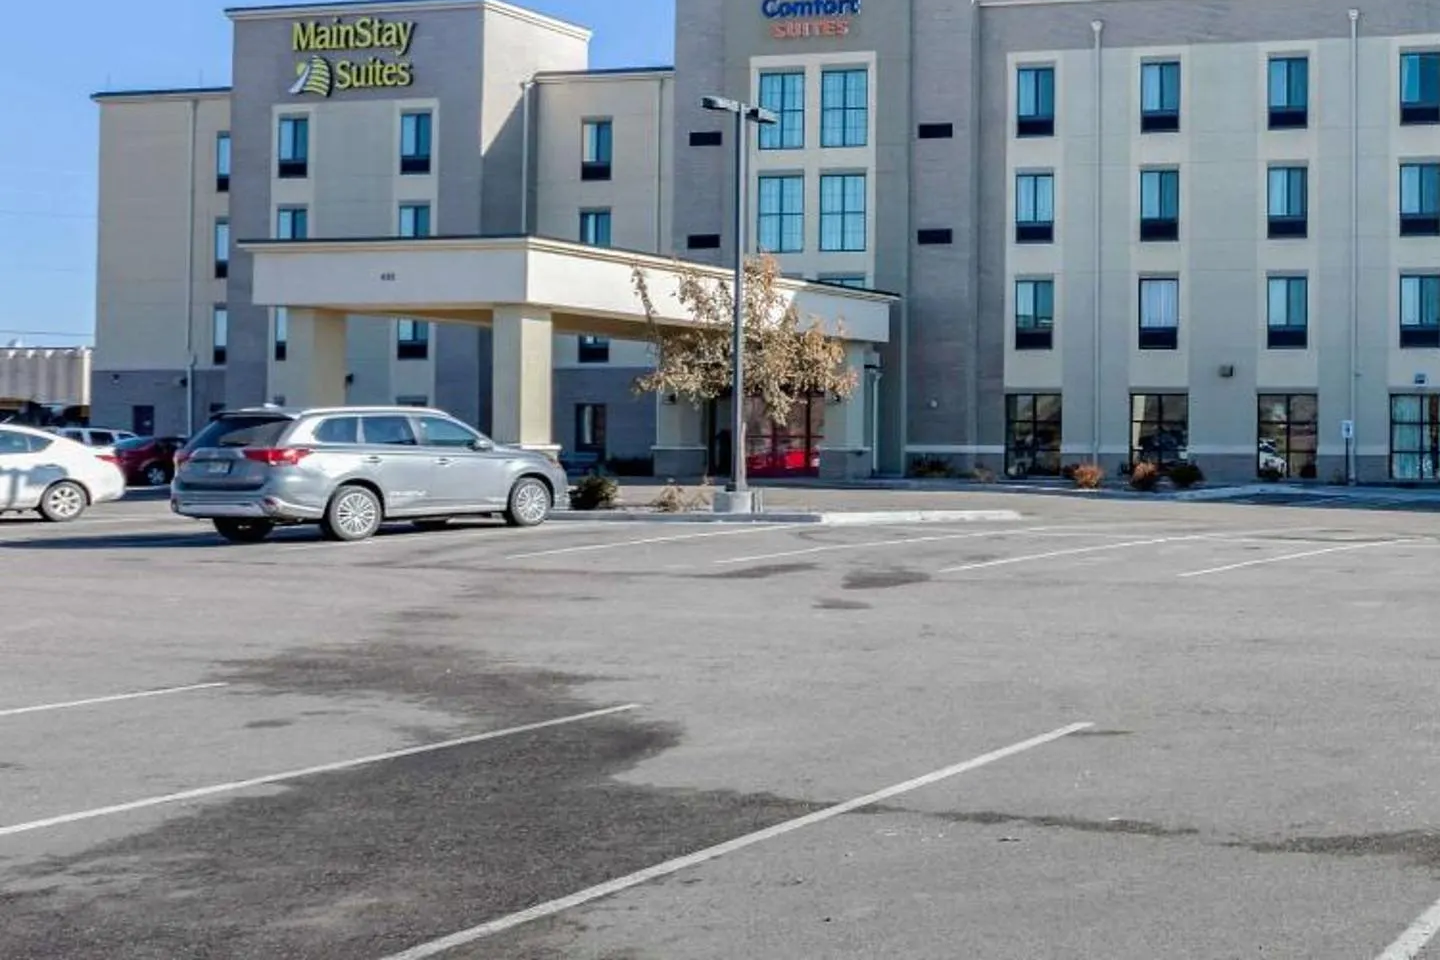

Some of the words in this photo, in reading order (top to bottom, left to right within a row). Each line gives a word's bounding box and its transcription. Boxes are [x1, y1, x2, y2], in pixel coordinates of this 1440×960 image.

[292, 17, 415, 56] MainStay
[769, 20, 849, 38] SUITES
[335, 56, 413, 90] Suites
